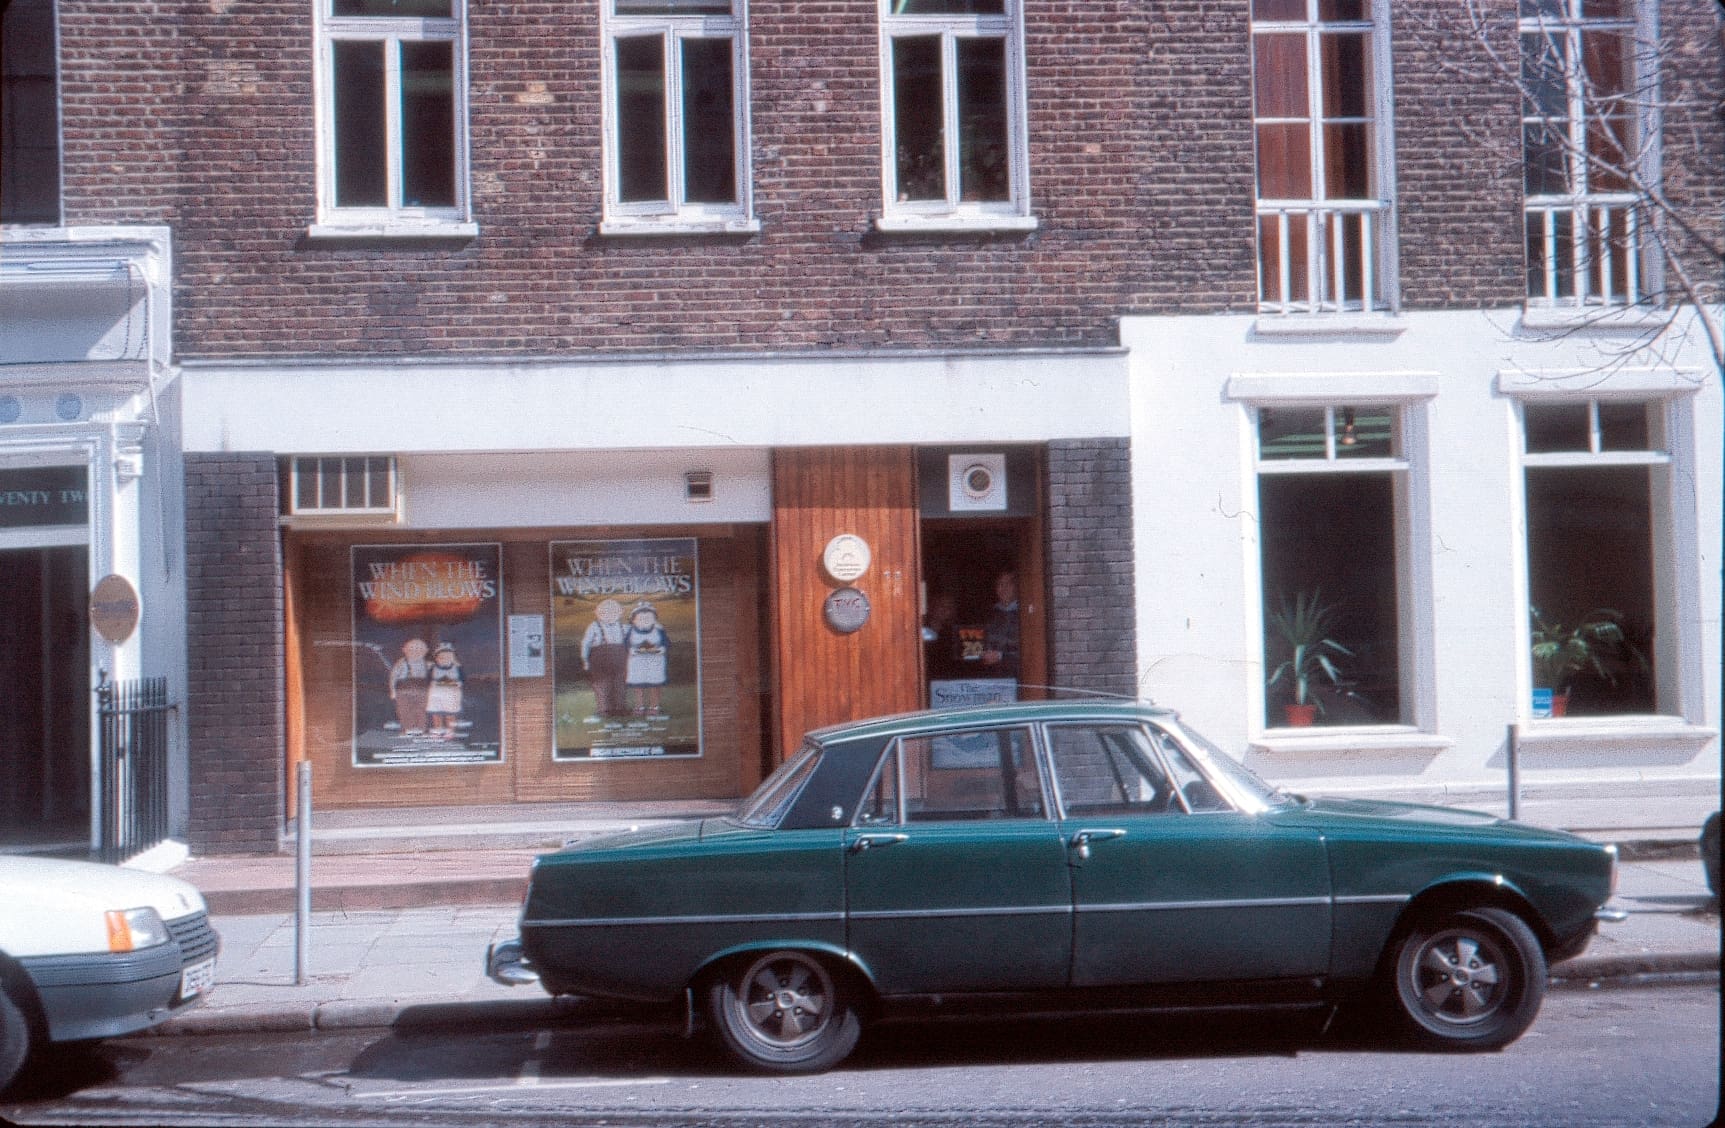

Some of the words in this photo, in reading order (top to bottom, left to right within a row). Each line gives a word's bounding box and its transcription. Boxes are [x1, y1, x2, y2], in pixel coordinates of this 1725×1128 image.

[60, 490, 88, 503] TW
[368, 561, 437, 580] WHEN
[447, 559, 488, 579] THE
[567, 558, 633, 576] WHEN
[643, 556, 683, 575] THE
[358, 581, 421, 600] WIND
[426, 579, 497, 599] BLOWS
[556, 577, 617, 595] WIND
[623, 575, 692, 594] BLOWS
